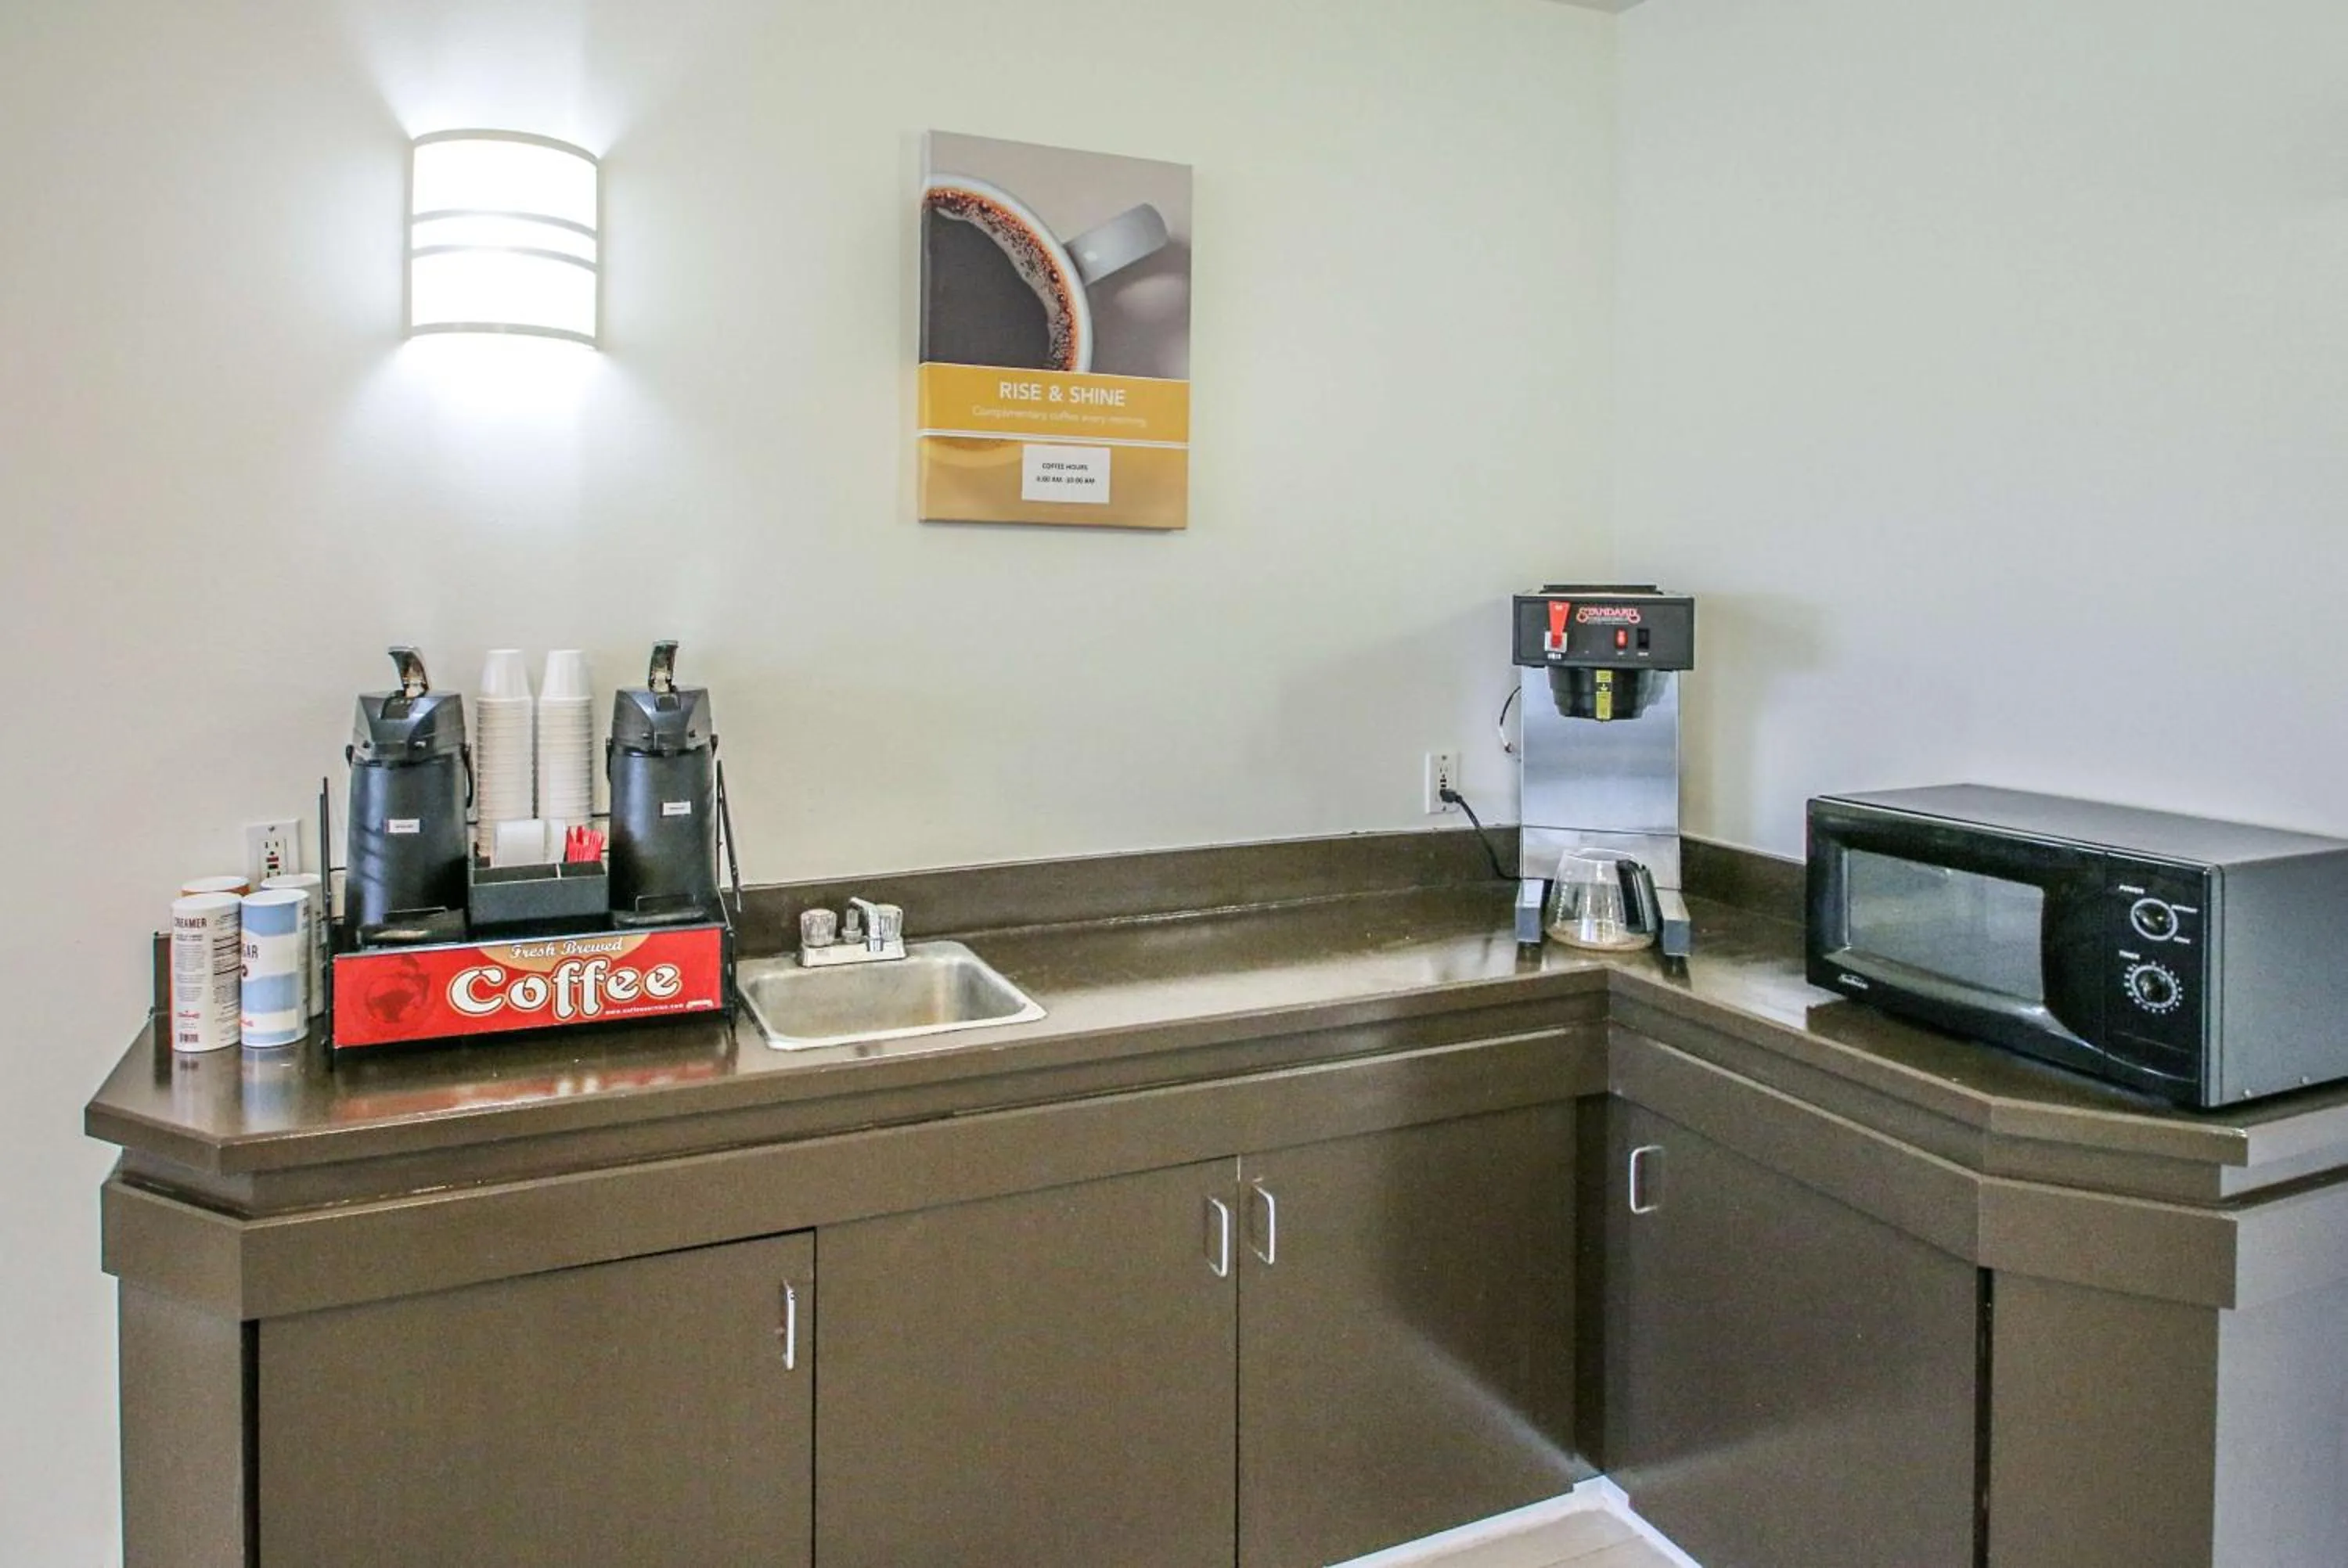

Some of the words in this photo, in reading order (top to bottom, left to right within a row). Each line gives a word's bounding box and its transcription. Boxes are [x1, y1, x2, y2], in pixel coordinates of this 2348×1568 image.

[999, 381, 1043, 401] RISE
[1048, 385, 1064, 402] &
[1069, 386, 1127, 408] SHINE
[972, 405, 1048, 421] Complimentary
[1050, 411, 1079, 420] coffee
[510, 940, 555, 958] Fresh
[561, 937, 624, 955] Brewed
[448, 956, 681, 1020] Coffee
